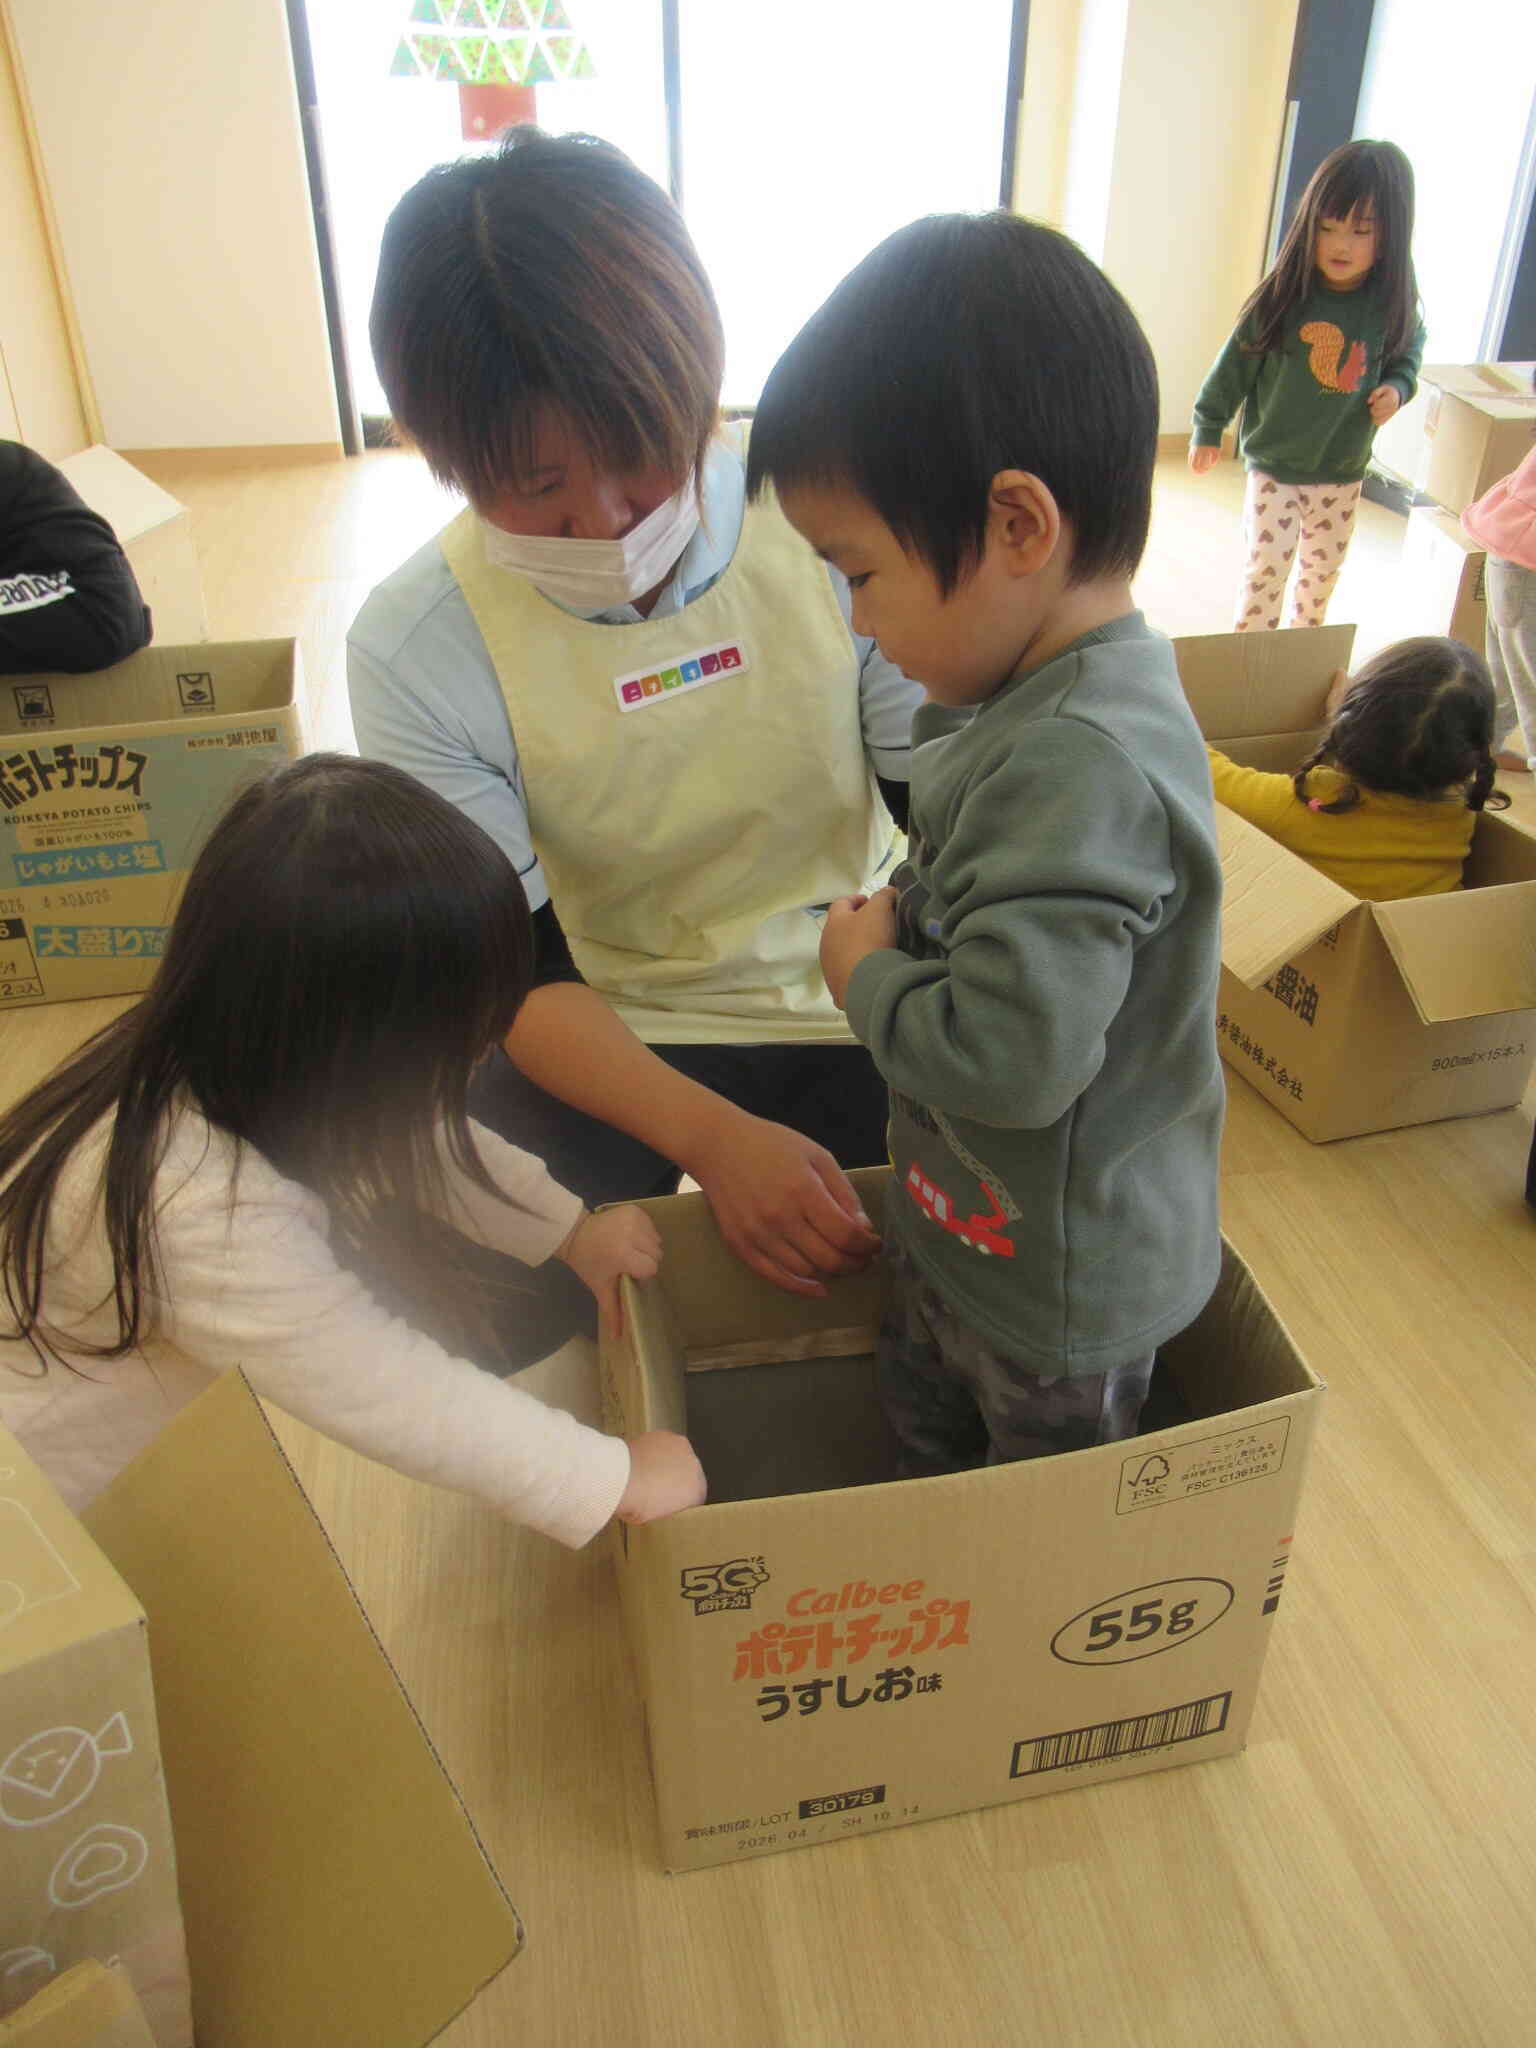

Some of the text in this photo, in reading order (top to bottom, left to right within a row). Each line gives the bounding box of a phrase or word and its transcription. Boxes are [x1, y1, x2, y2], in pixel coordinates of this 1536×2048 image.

[63, 805, 111, 819] POTATO
[114, 802, 152, 815] CHIPS
[1131, 1483, 1168, 1501] FSC
[785, 1579, 927, 1618] Calbee
[732, 1597, 971, 1682] ポテトチップス
[1084, 1598, 1198, 1653] 55g
[756, 1665, 944, 1723] うすしお味
[809, 1791, 876, 1817] 30179
